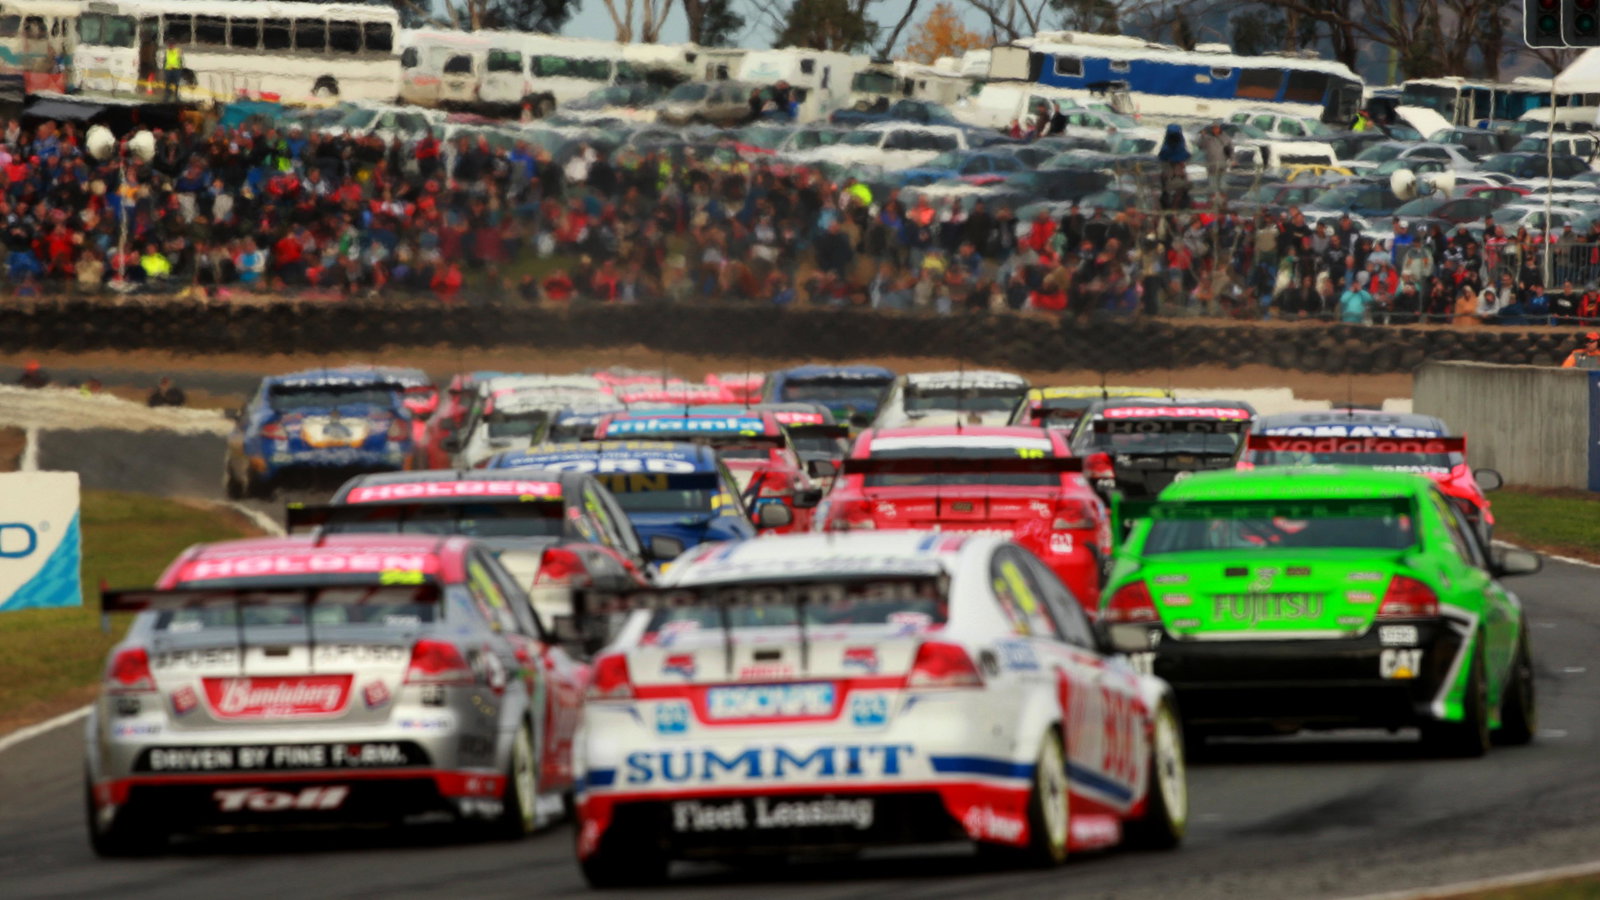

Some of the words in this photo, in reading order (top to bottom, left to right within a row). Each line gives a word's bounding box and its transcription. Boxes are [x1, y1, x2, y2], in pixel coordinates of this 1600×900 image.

[1110, 406, 1240, 418] HOLDEN
[359, 481, 549, 500] HOLDEN
[193, 555, 425, 578] HOLDEN
[1212, 594, 1326, 626] FUJITSU
[1381, 649, 1424, 679] CAT
[150, 747, 234, 770] DRIVEN
[238, 746, 269, 769] BY
[273, 745, 326, 767] FINE
[626, 743, 916, 784] SUMMIT
[672, 800, 748, 832] Fleet
[756, 796, 875, 829] Leasing
